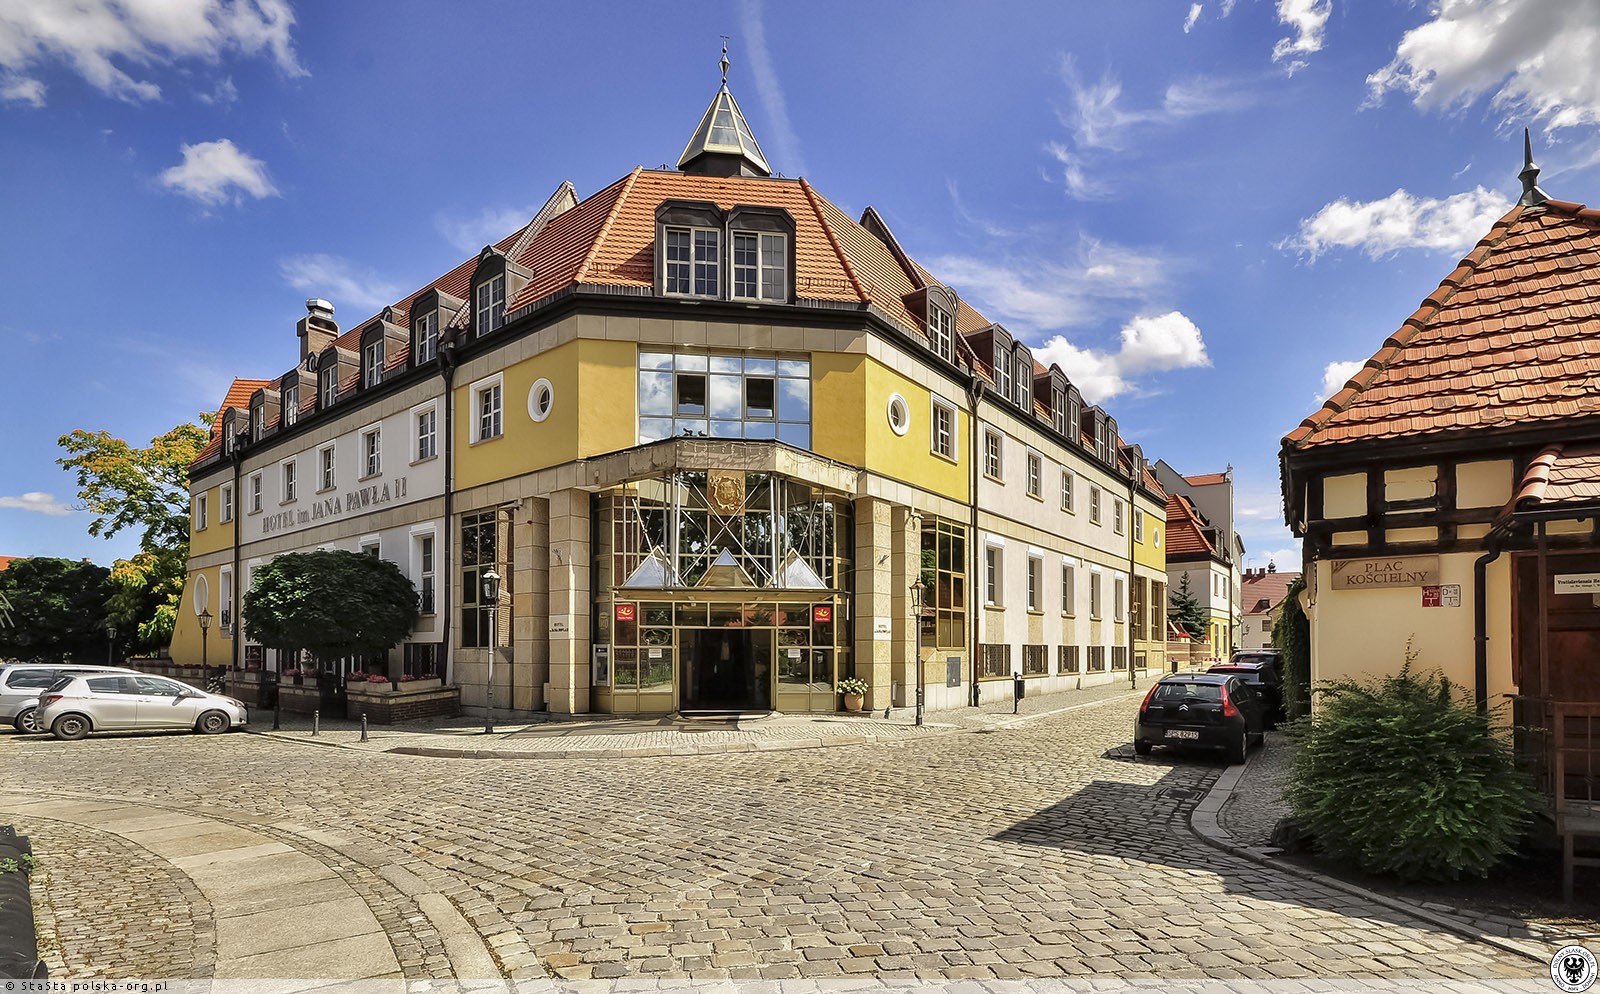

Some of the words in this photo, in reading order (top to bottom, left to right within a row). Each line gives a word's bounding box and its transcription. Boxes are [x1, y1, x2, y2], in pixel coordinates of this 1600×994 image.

[262, 509, 293, 533] HOTEL
[311, 497, 342, 520] JANA
[346, 482, 391, 512] PAWŁA
[394, 477, 407, 498] II
[1365, 561, 1403, 572] PLAC
[1346, 571, 1428, 584] KOŚCIELNY
